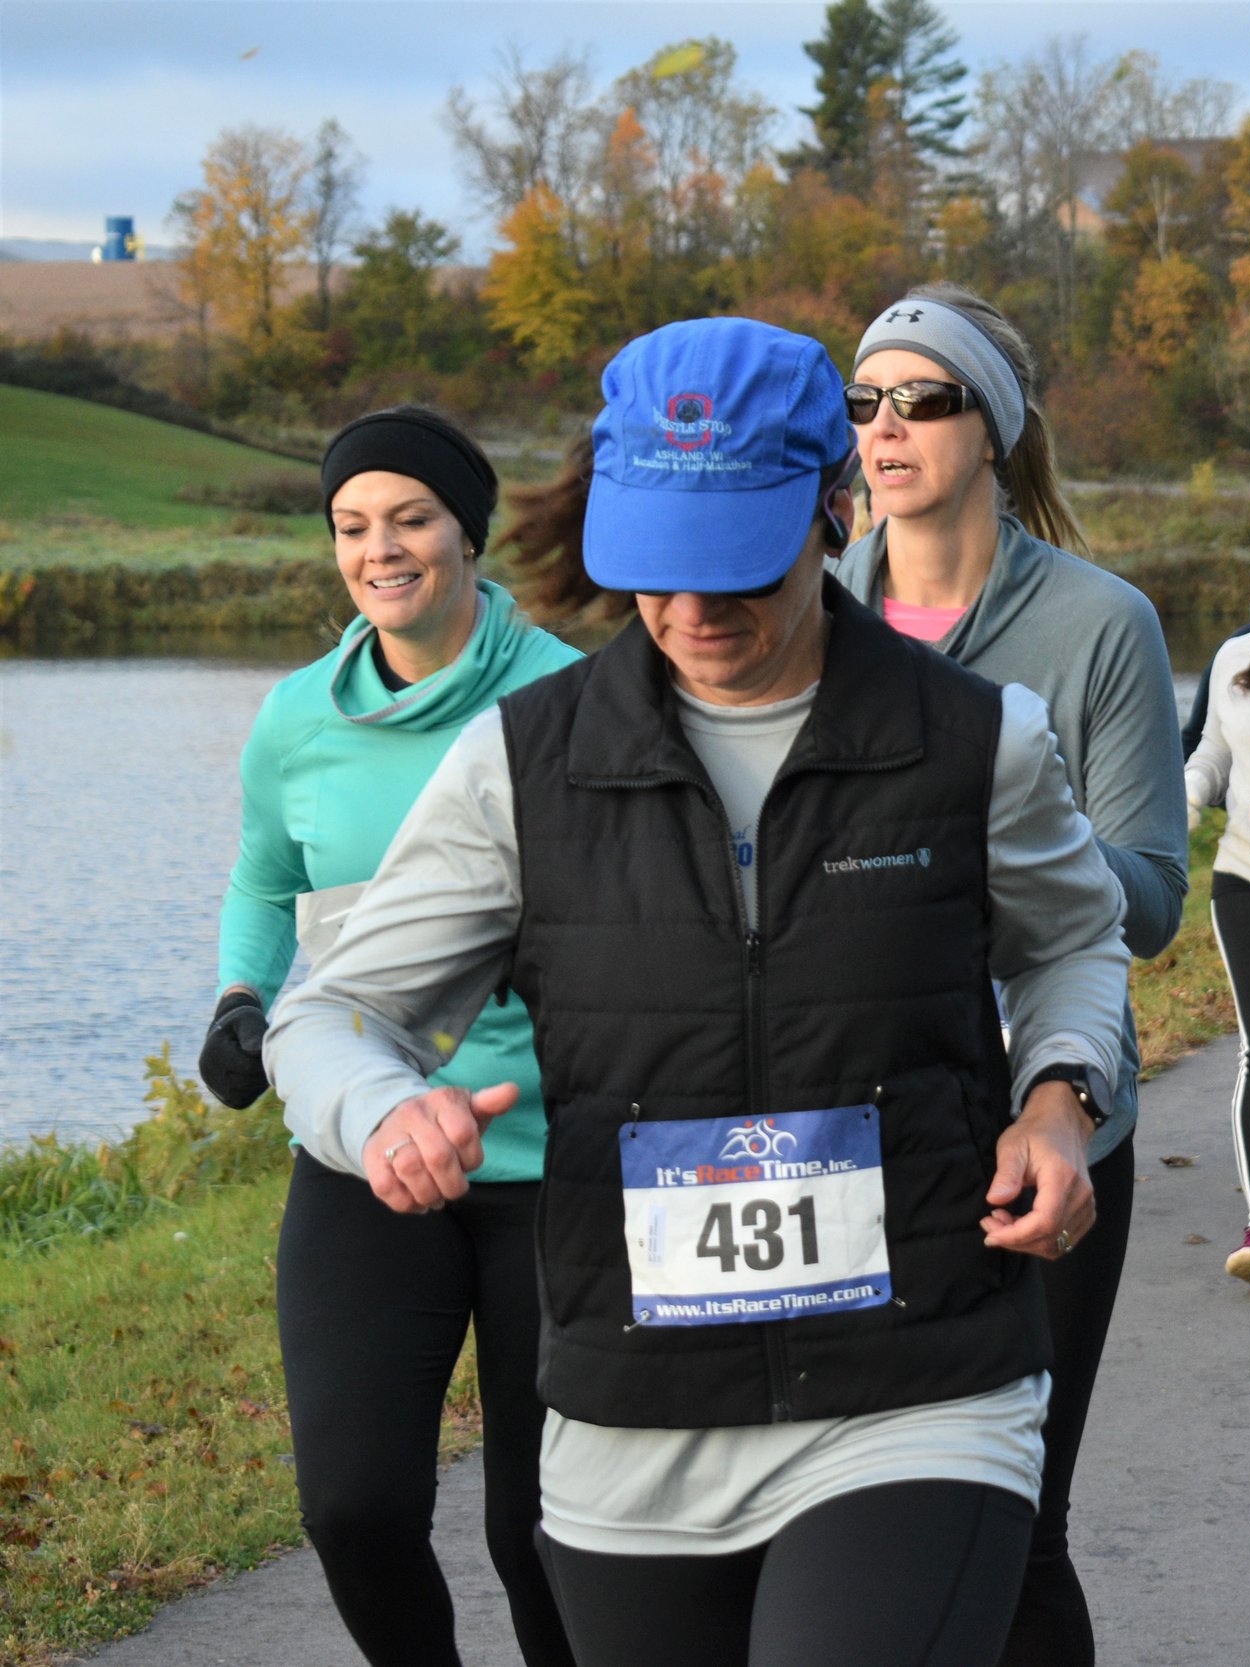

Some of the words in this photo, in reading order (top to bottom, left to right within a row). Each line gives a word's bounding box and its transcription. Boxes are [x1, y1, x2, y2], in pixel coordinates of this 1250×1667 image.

[709, 451, 724, 460] WI
[822, 851, 915, 874] trekwomen
[696, 1194, 820, 1273] 431
[655, 1284, 876, 1317] www.ItsRaceTime.com
